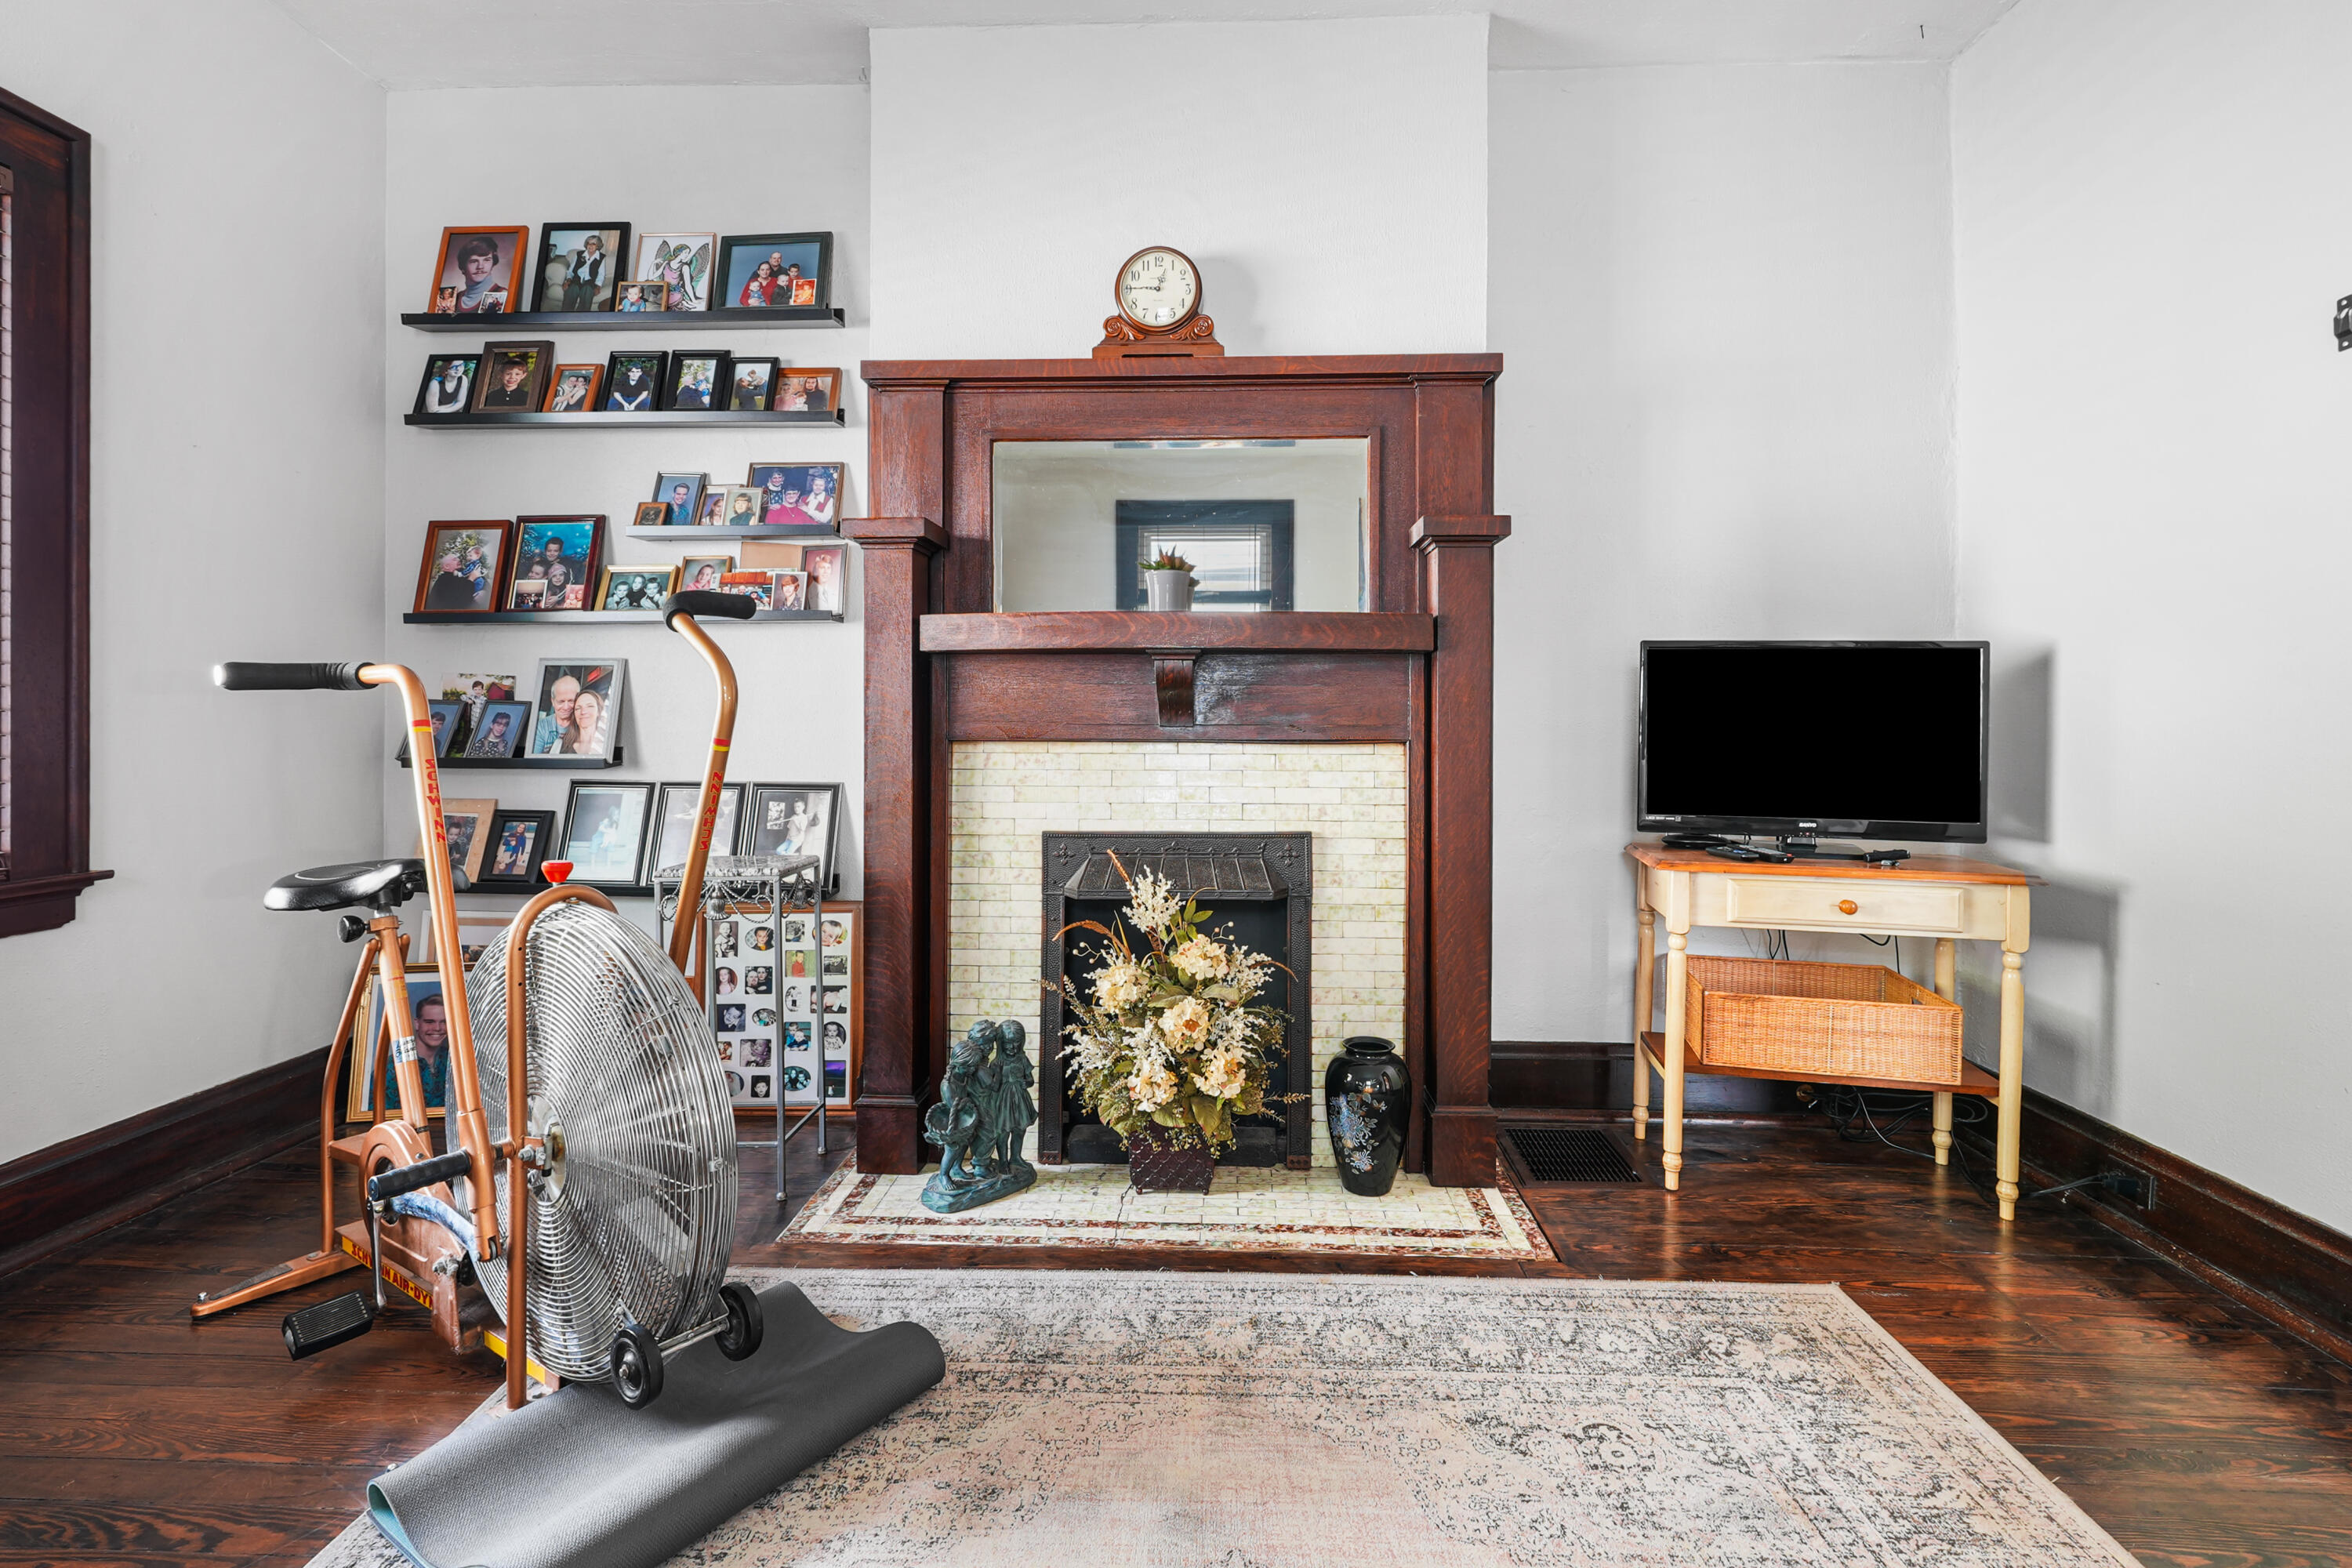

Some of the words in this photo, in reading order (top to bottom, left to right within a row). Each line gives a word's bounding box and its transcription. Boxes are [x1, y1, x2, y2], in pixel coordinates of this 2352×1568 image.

[1142, 260, 1149, 271] 11
[1155, 256, 1163, 267] 12
[1171, 260, 1174, 270] 1
[1131, 270, 1140, 281] 10
[1180, 269, 1186, 281] 2
[1124, 284, 1132, 295] 9
[1185, 284, 1192, 295] 3
[1131, 298, 1138, 310] 8
[1179, 298, 1185, 309] 4
[1142, 308, 1149, 319] 7
[1170, 307, 1176, 319] 5
[425, 758, 446, 842] SCHWINN
[699, 771, 723, 851] SCHWINN
